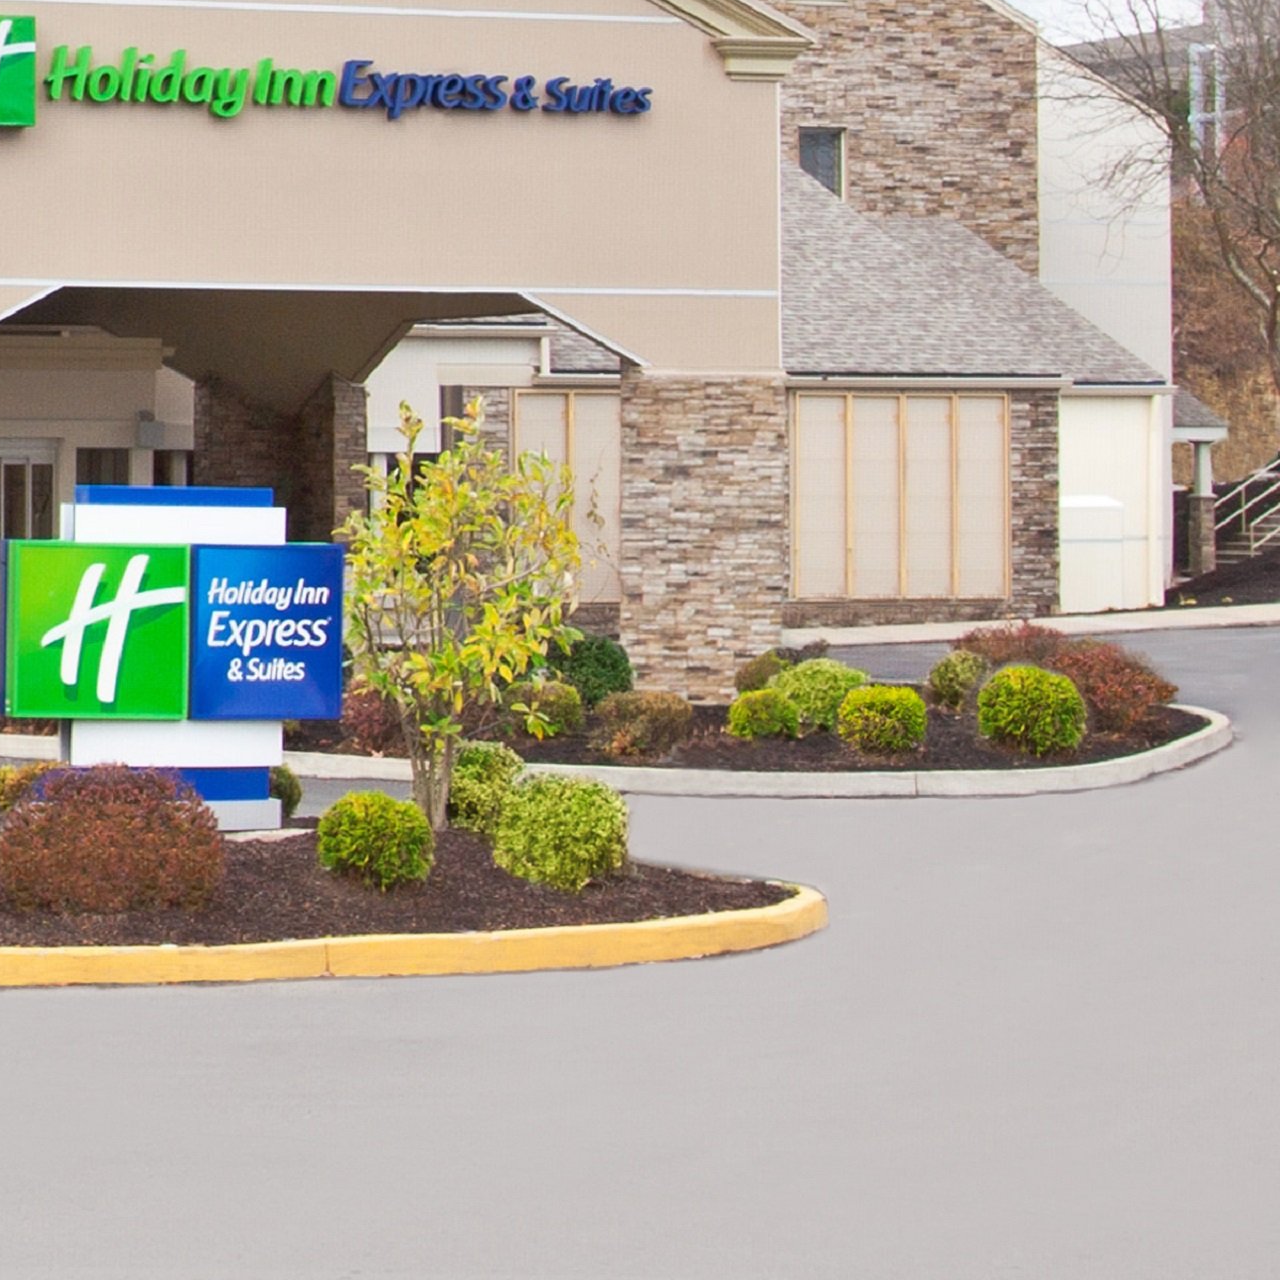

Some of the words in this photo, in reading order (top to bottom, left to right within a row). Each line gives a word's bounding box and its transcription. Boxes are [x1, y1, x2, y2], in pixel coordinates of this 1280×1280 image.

[45, 45, 250, 119] Holiday
[253, 57, 336, 107] Inn
[339, 59, 508, 121] Express
[509, 75, 539, 112] &
[541, 76, 652, 115] Suites
[207, 577, 292, 610] Holiday
[293, 577, 330, 605] Inn
[206, 610, 329, 656] Express
[226, 657, 244, 681] &
[245, 657, 306, 681] Suites
